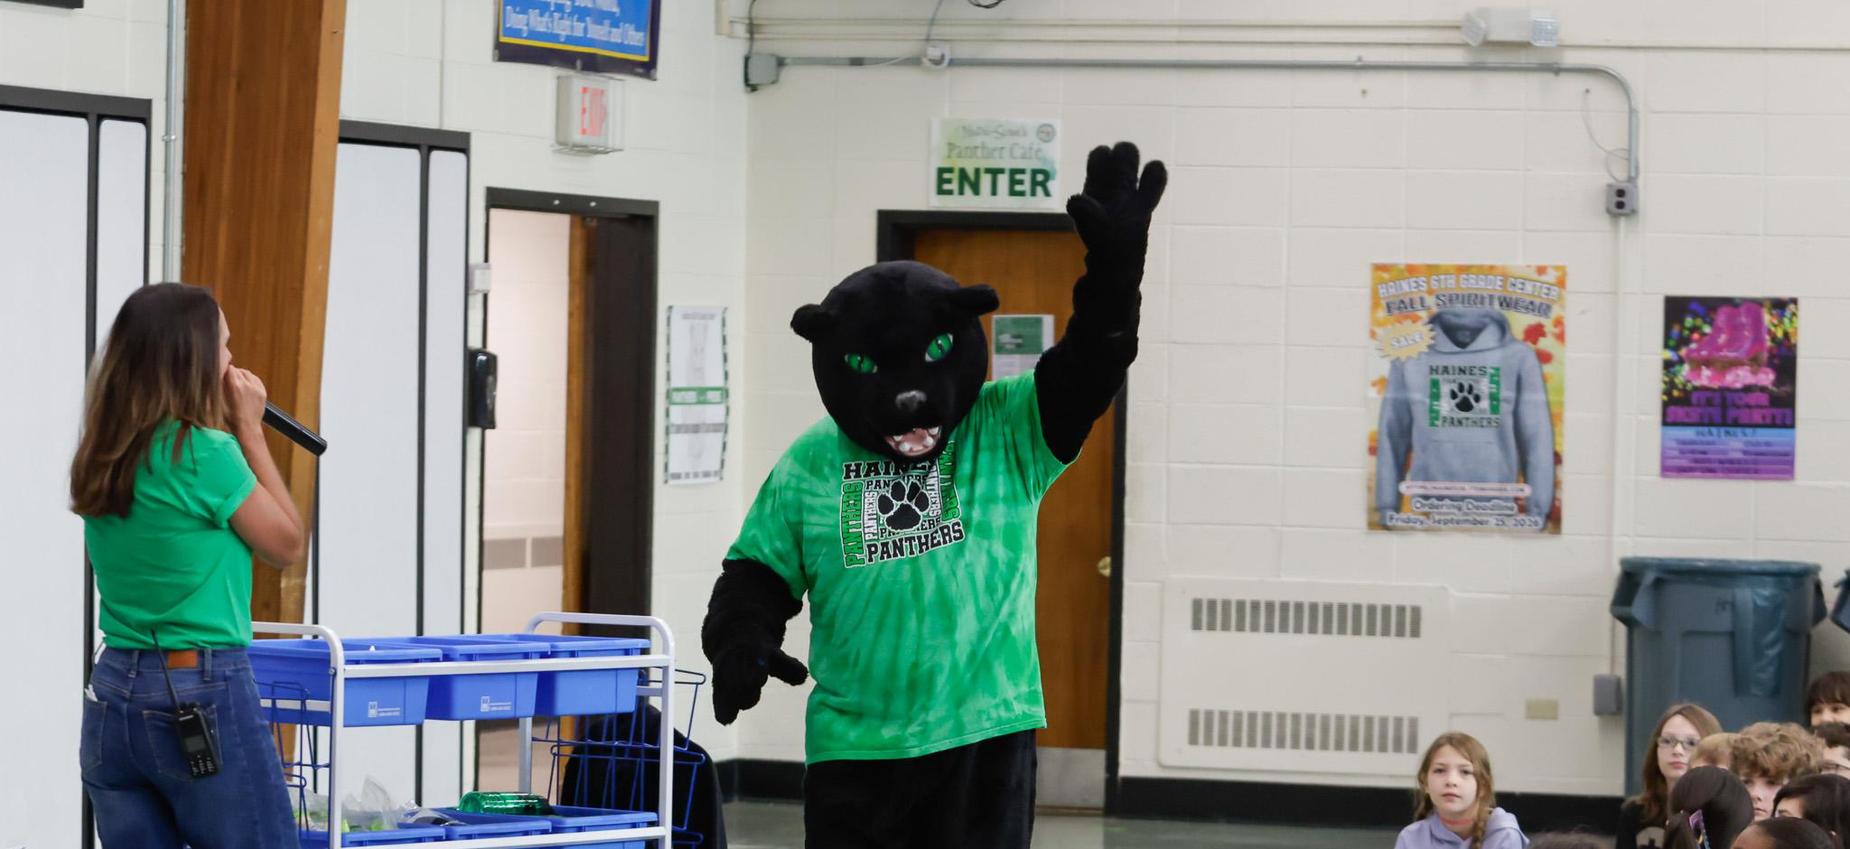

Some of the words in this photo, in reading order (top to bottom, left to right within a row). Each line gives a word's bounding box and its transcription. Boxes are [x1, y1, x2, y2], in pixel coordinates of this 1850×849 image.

[936, 166, 1053, 197] ENTER
[1386, 296, 1431, 316] FALL
[1429, 365, 1488, 376] HAINES
[1441, 416, 1501, 428] PANTHERS
[1413, 499, 1463, 513] Ordering
[1465, 500, 1516, 512] Deadline
[841, 482, 866, 567] PANTHERS
[866, 520, 965, 564] PANTHERS
